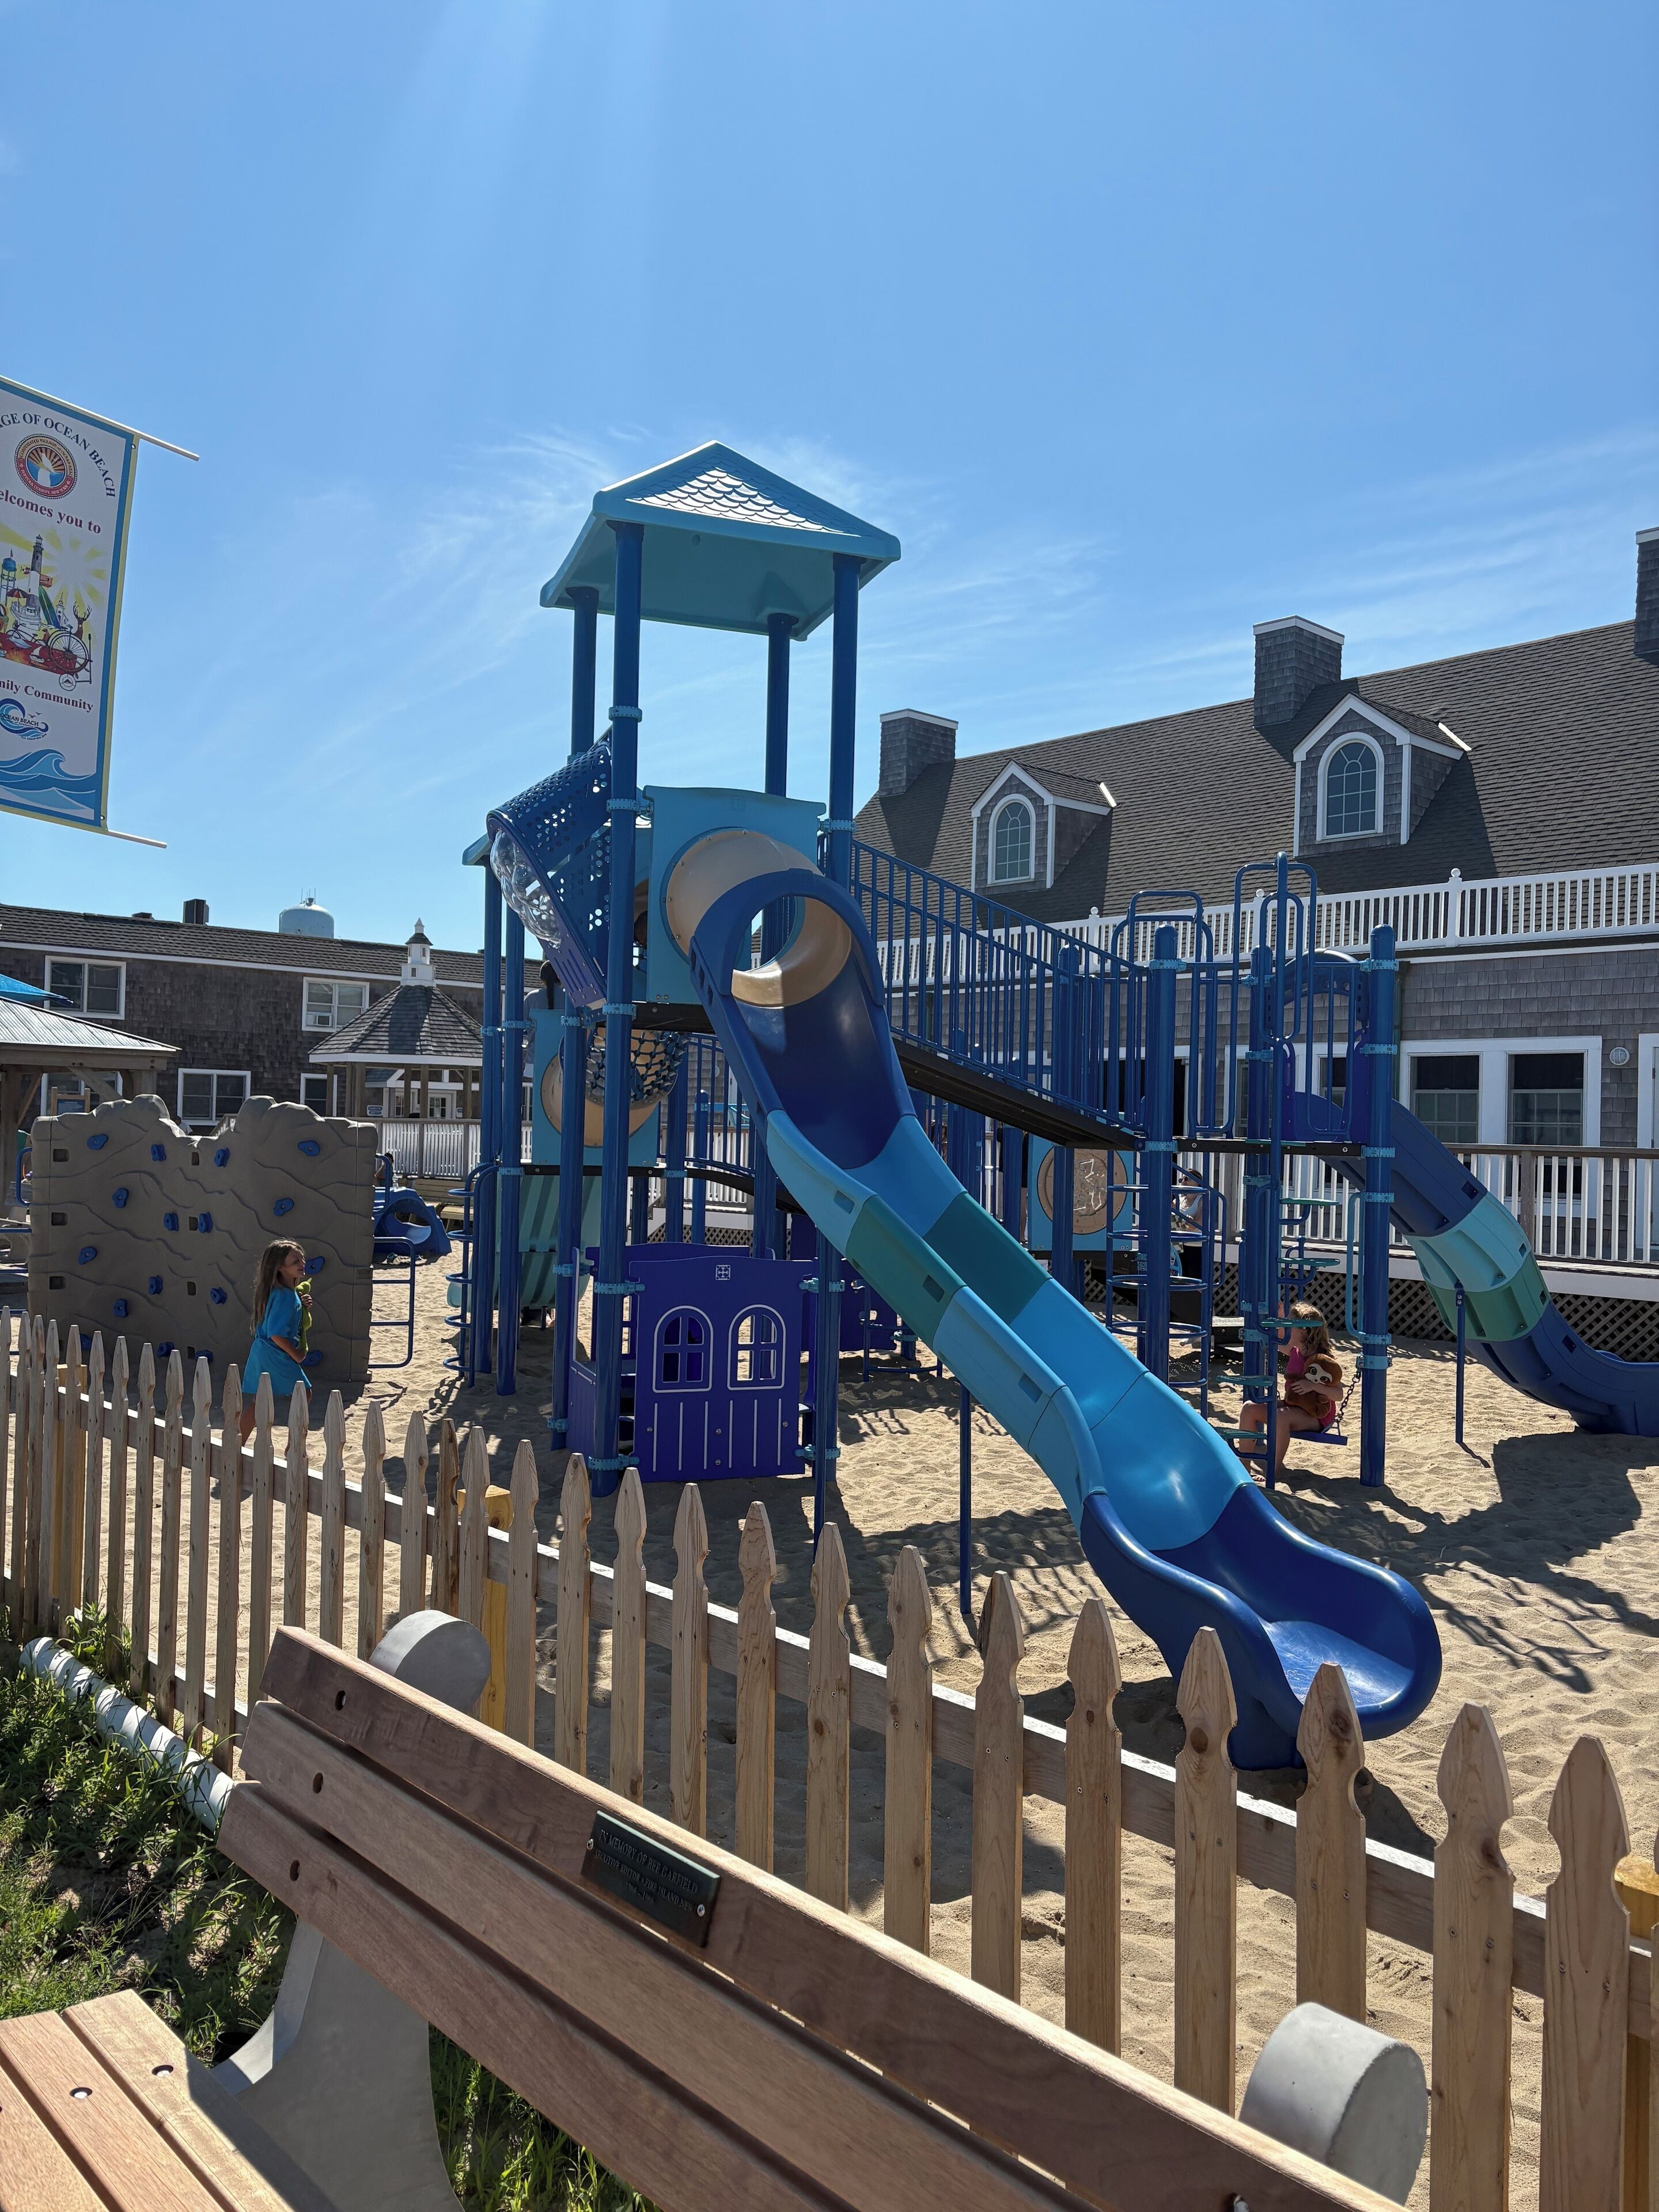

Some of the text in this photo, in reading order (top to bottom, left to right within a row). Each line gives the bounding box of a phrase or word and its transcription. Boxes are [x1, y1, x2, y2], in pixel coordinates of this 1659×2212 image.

[0, 413, 20, 428] GE
[22, 413, 41, 425] OF
[44, 418, 90, 450] OCEAN
[88, 449, 116, 498] BEACH
[57, 511, 83, 529] you
[88, 520, 101, 534] to
[24, 685, 94, 713] Community
[20, 718, 39, 726] BEACH
[599, 1829, 608, 1843] IN
[608, 1834, 637, 1859] MEMORY
[637, 1851, 647, 1866] OF
[662, 1865, 698, 1894] GARFIELD
[657, 1885, 679, 1904] ISLAND
